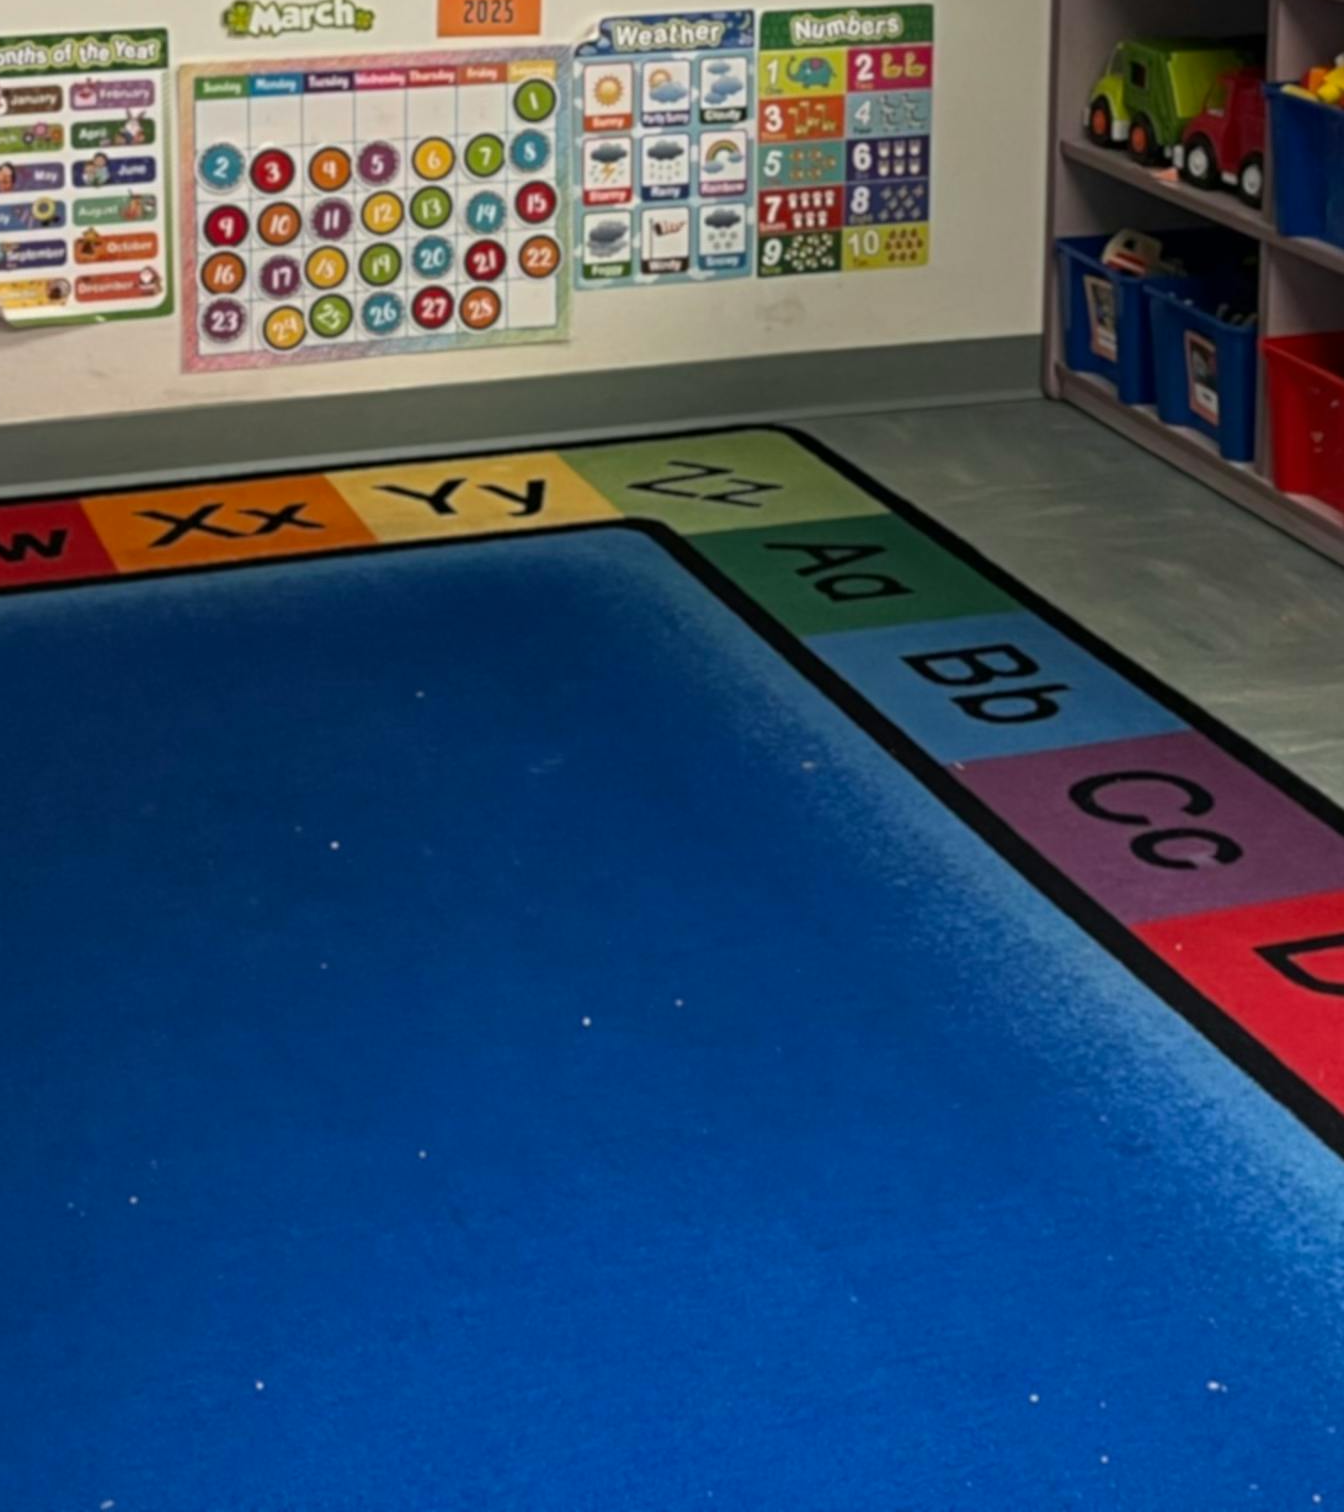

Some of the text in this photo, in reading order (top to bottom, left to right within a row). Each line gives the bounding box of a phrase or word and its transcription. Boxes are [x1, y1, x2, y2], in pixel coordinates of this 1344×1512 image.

[615, 23, 721, 47] Weather
[794, 16, 901, 41] Numbers
[52, 44, 73, 64] of
[79, 42, 110, 63] the
[114, 40, 158, 59] Year
[766, 58, 779, 85] 1
[854, 53, 874, 81] 2
[10, 93, 58, 108] January
[529, 92, 539, 111] 1
[764, 104, 783, 133] 3
[855, 100, 872, 126] 4
[371, 154, 385, 175] 5
[426, 150, 442, 170] 6
[479, 145, 492, 166] 7
[763, 150, 783, 177] 5
[852, 142, 872, 171] 6
[34, 170, 59, 184] May
[117, 164, 147, 177] June
[213, 156, 230, 179] 2
[265, 161, 281, 183] 3
[422, 198, 442, 219] 13
[526, 193, 547, 214] 15
[763, 195, 783, 224] 7
[850, 186, 870, 214] 8
[269, 214, 290, 236] 10
[323, 209, 340, 231] 11
[373, 203, 393, 224] 12
[476, 204, 497, 223] 14
[107, 239, 154, 254] October
[762, 238, 783, 266] 9
[848, 230, 880, 258] 10
[372, 253, 391, 276] 19
[420, 247, 443, 269] 20
[473, 249, 497, 274] 21
[527, 247, 552, 268] 22
[214, 264, 235, 285] 16
[272, 266, 292, 289] 17
[316, 303, 341, 330] 25
[369, 302, 397, 326] 26
[421, 297, 447, 319] 27
[468, 298, 493, 320] 28
[211, 310, 238, 332] 23
[626, 459, 786, 509] Zz
[376, 477, 548, 519] Yy
[135, 501, 327, 550] Xx
[763, 540, 917, 605] Aa
[901, 641, 1061, 728] Bb
[1067, 768, 1245, 873] Cc
